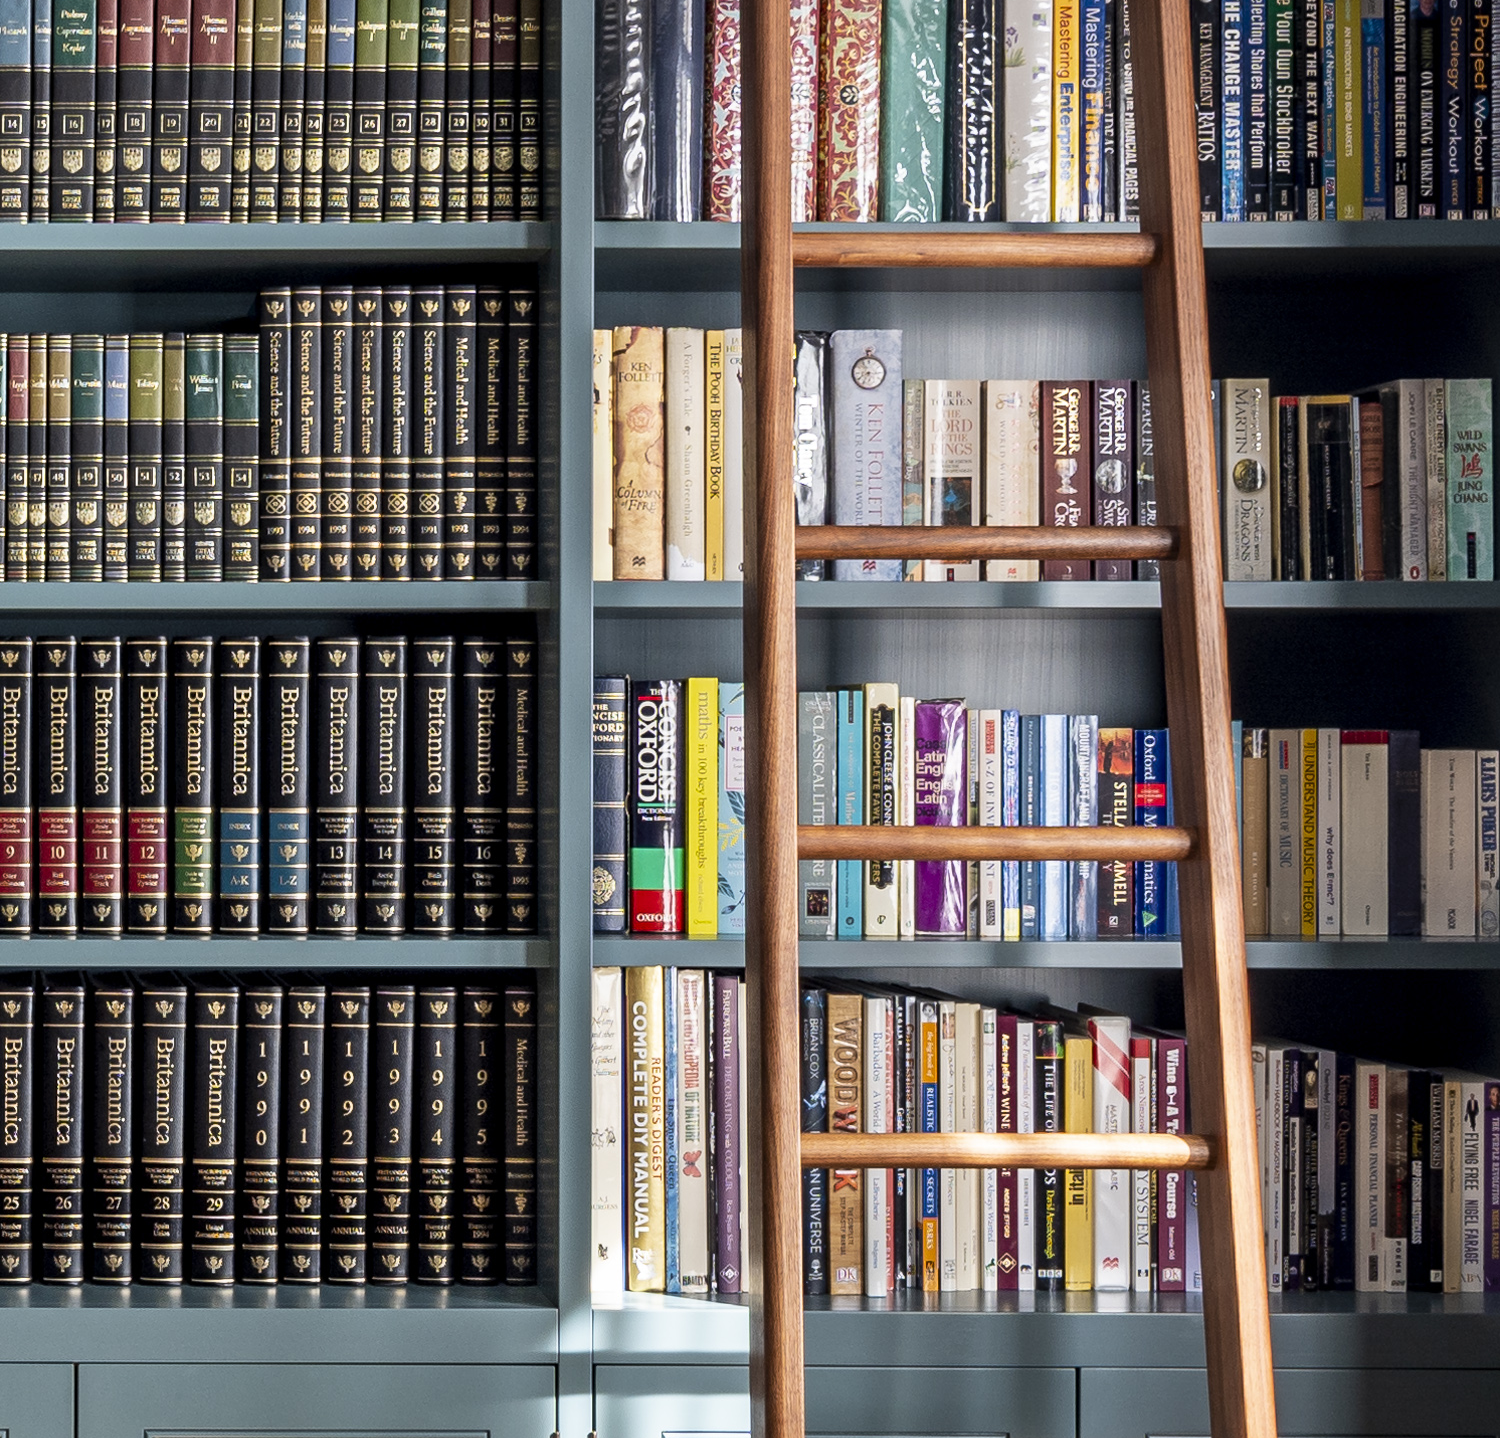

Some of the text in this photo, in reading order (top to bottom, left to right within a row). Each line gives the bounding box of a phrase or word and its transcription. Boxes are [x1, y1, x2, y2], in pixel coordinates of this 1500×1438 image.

[1276, 11, 1292, 43] Your
[1470, 15, 1489, 90] Project
[1225, 29, 1240, 95] CHANGE
[1276, 49, 1292, 80] Own
[130, 117, 140, 126] 18
[205, 118, 216, 126] 20
[1225, 102, 1240, 170] MASTER
[1276, 86, 1293, 173] Stockbroker
[1395, 76, 1406, 158] ENGINEERING
[1474, 98, 1487, 171] Workout
[270, 332, 283, 455] Science and the Future
[710, 342, 721, 499] THE POOH BIRTHDAY BOOK
[1053, 388, 1067, 455] MARTIN
[1453, 443, 1487, 452] SWANS
[1457, 431, 1482, 441] WILD
[1454, 493, 1488, 504] CHANG
[1457, 481, 1482, 491] JUNG
[330, 686, 348, 796] Britannica
[379, 686, 398, 796] Britannica
[638, 701, 658, 803] OXFORD
[1143, 735, 1156, 780] Oxford
[330, 846, 343, 859] 13
[428, 846, 442, 858] 15
[809, 1018, 819, 1079] BRIAN COX
[632, 1001, 649, 1237] COMPLETE DIY MANUAL
[651, 1057, 662, 1181] READER'S DIGEST
[1464, 1132, 1479, 1264] FLYING FREE NIGEL FARAGE
